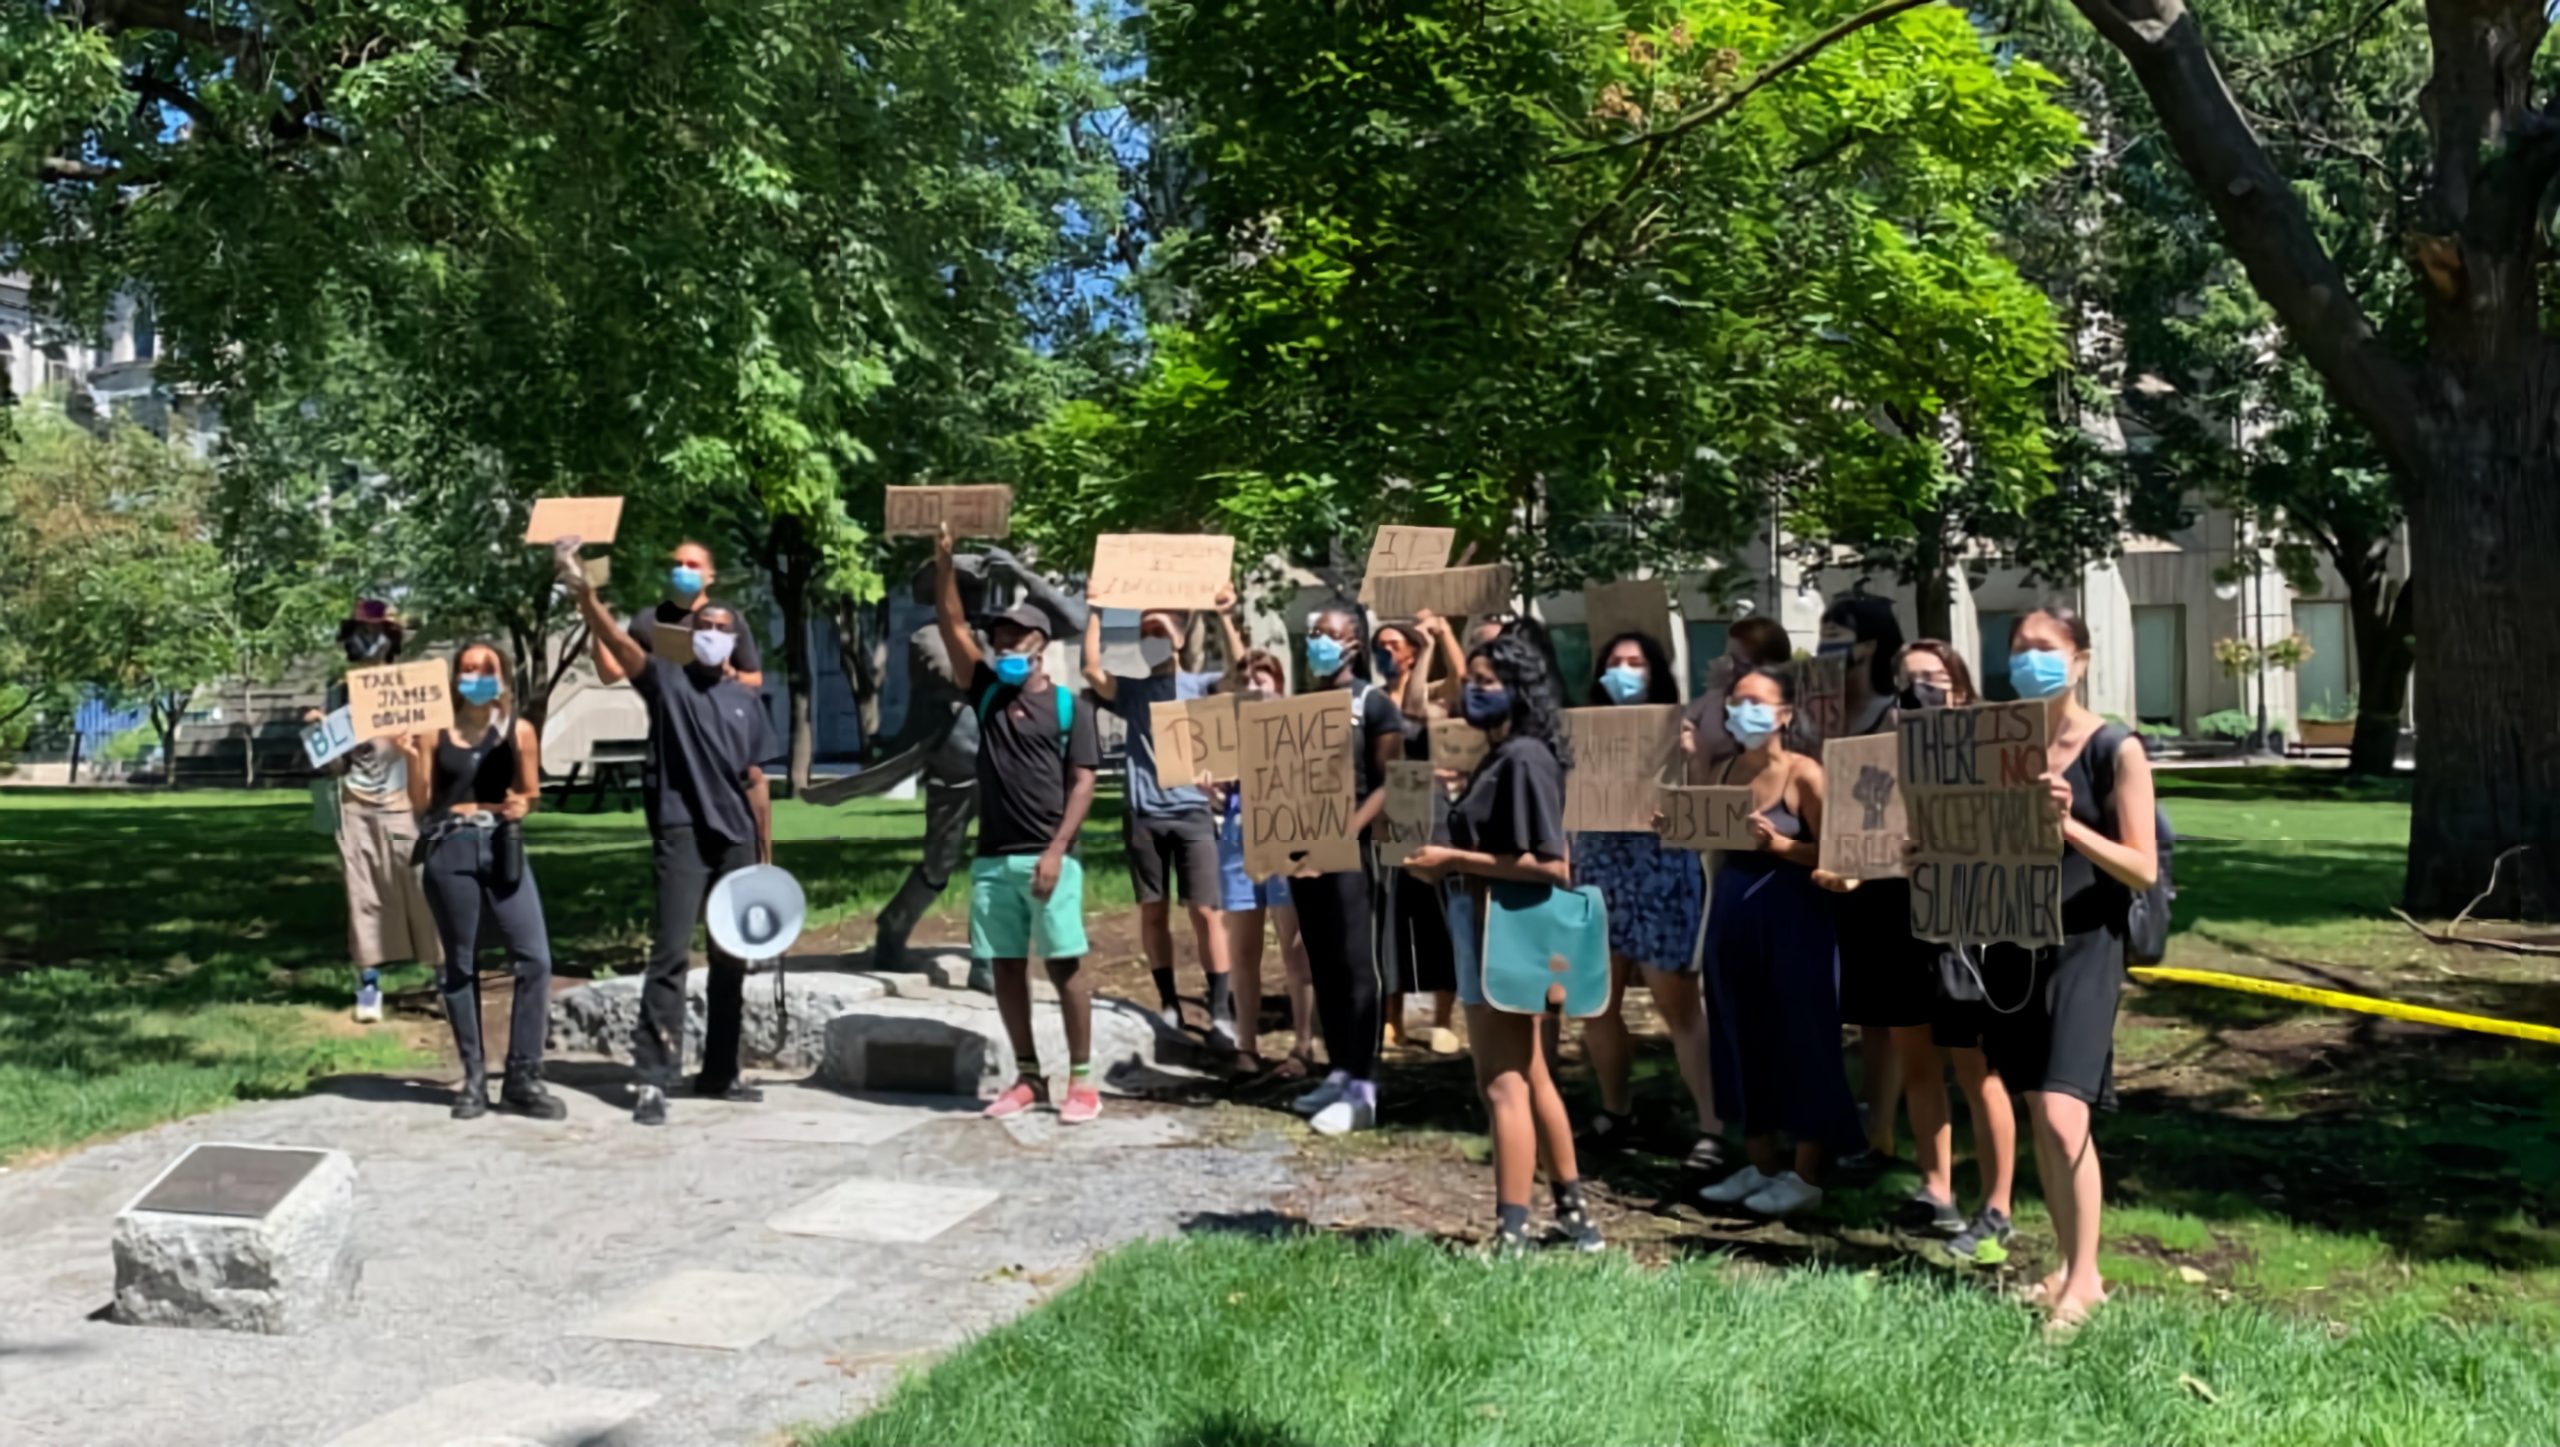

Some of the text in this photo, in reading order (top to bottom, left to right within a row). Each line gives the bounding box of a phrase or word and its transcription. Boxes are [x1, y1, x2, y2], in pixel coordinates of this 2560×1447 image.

[358, 671, 405, 689] TAKE
[377, 685, 443, 708] JAMES
[310, 719, 349, 757] BL
[372, 709, 426, 728] DOWN
[1163, 716, 1236, 763] BL
[1252, 707, 1347, 761] TAKE
[1902, 703, 2032, 785] THERE IS
[2000, 744, 2046, 787] NO
[1253, 795, 1350, 847] DOWN
[1667, 791, 1747, 841] BLM
